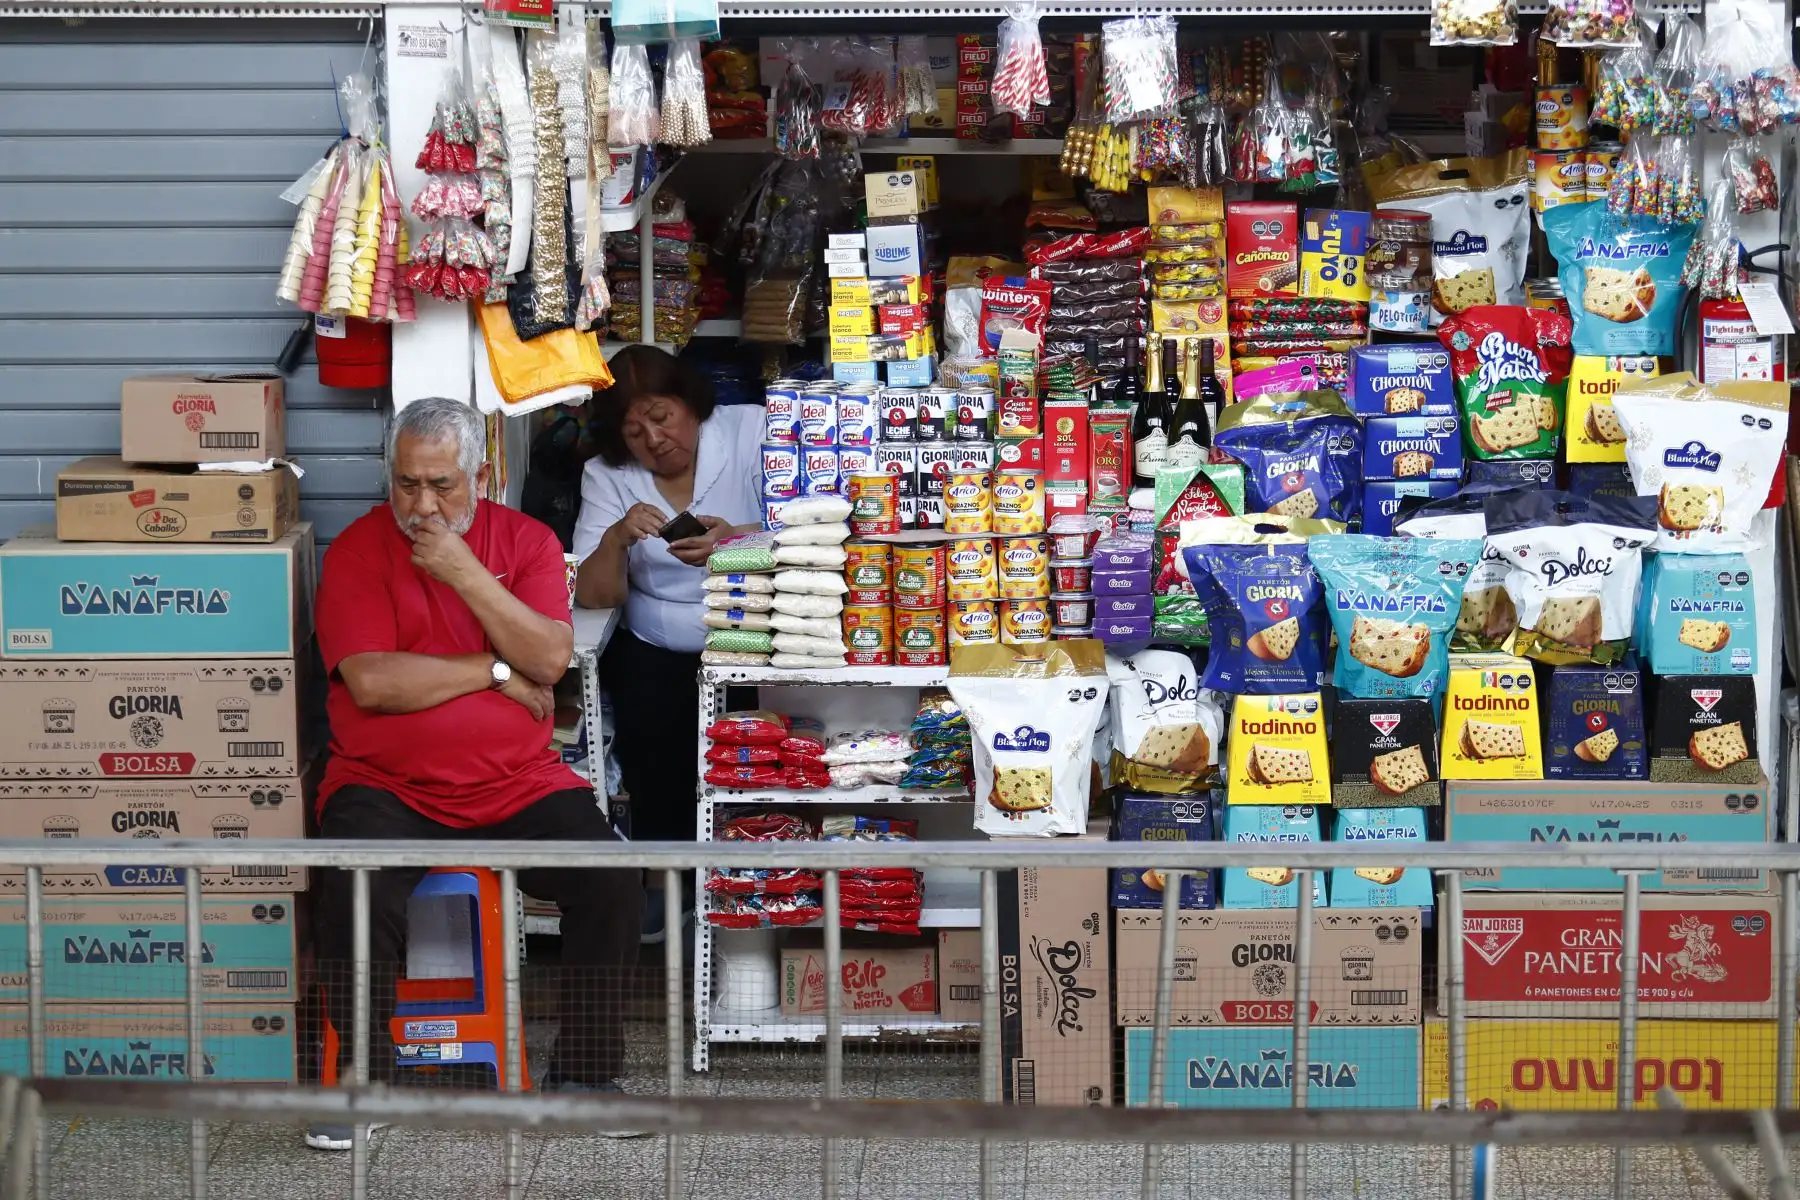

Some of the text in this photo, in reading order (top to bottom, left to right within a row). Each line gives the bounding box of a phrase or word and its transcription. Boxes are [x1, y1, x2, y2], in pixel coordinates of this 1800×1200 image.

[965, 52, 985, 61] FIELD
[963, 84, 983, 92] FIELD
[962, 115, 982, 123] FIELD
[875, 247, 911, 258] SUBLIME
[1236, 251, 1289, 264] Cañonazo
[1320, 228, 1341, 282] TUYO
[983, 289, 1040, 304] winter's
[1380, 308, 1422, 322] PELOTITAS
[1712, 326, 1744, 334] Fighting
[1478, 332, 1538, 368] Buon
[1370, 374, 1432, 393] CHOCOTÓN
[1580, 379, 1620, 394] todi
[172, 400, 216, 415] GLORIA
[768, 399, 792, 413] Ideal
[882, 397, 915, 409] GLORIA
[801, 404, 826, 418] Ideal
[840, 404, 864, 418] Ideal
[886, 426, 910, 434] LECHE
[1378, 438, 1441, 456] CHOCOTÓN
[765, 455, 792, 470] Ideal
[808, 456, 835, 470] Ideal
[840, 455, 867, 470] Ideal
[880, 451, 912, 463] GLORIA
[1668, 453, 1698, 463] Blanca
[1267, 457, 1319, 478] GLORIA
[953, 486, 976, 496] Arica
[997, 486, 1018, 496] Arica
[1184, 488, 1214, 500] Feliz
[1172, 500, 1221, 522] Navidad
[162, 515, 178, 524] Dos
[144, 523, 180, 533] Caballos
[954, 553, 978, 563] Arica
[1008, 551, 1032, 560] Arica
[1110, 556, 1133, 564] Costa
[1246, 586, 1303, 602] GLORIA
[1112, 602, 1136, 610] Costa
[965, 613, 989, 624] Arica
[1017, 613, 1041, 623] Arica
[1110, 626, 1133, 634] Costa
[12, 634, 47, 645] BOLSA
[109, 696, 183, 720] GLORIA
[1455, 695, 1530, 710] todinno
[1572, 700, 1620, 716] GLORIA
[1242, 719, 1316, 734] todinno
[113, 757, 182, 772] BOLSA
[112, 810, 180, 833] GLORIA
[1141, 828, 1187, 841] GLORIA
[122, 868, 177, 884] CAJA
[1485, 919, 1522, 932] JORGE
[1560, 929, 1624, 946] GRAN
[1002, 955, 1017, 1018] BOLSA
[1047, 940, 1096, 1037] Dolcci
[1525, 987, 1532, 996] 6
[1535, 988, 1592, 997] PANETONES
[1594, 988, 1608, 996] EN
[1638, 988, 1649, 996] DE
[1652, 987, 1668, 997] 900
[1671, 989, 1676, 999] g
[1679, 987, 1693, 997] c/u
[856, 989, 884, 1000] Forti
